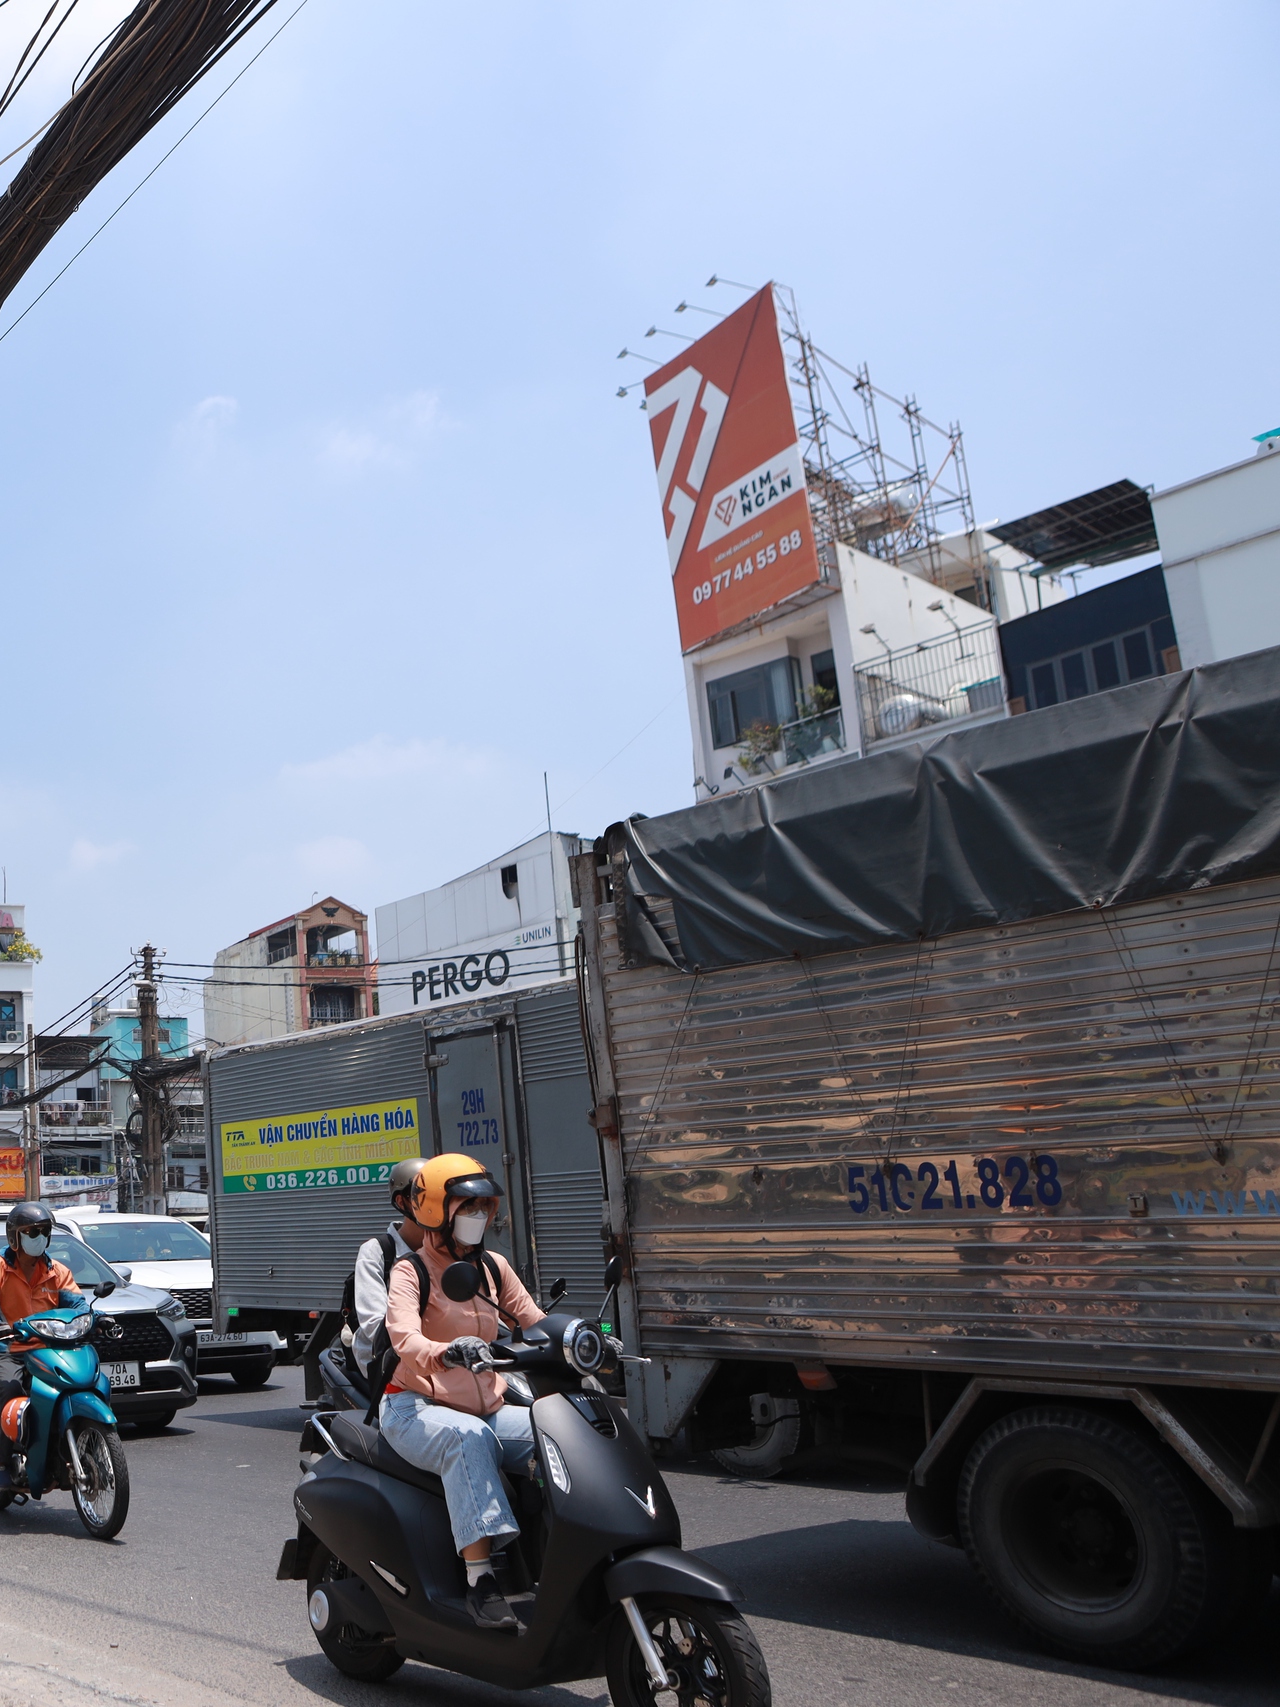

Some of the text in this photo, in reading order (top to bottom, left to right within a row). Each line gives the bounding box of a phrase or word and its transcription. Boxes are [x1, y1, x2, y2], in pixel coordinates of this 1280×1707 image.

[740, 471, 772, 500] KIM
[742, 475, 792, 516] NGAN
[692, 530, 802, 604] 09 77 44 55 88
[522, 926, 552, 944] UNILIN
[412, 949, 510, 1005] PERGO
[462, 1088, 485, 1116] 29H
[226, 1130, 246, 1142] TTA
[258, 1106, 414, 1148] VẬN CHUYỂN HÀNG HÓA
[457, 1118, 499, 1146] 722.73
[244, 1152, 275, 1169] TRUNG
[277, 1150, 300, 1168] NAM
[303, 1150, 311, 1164] &
[314, 1146, 335, 1164] CÁC
[397, 1134, 419, 1157] TÂY
[266, 1165, 395, 1190] 036.226.00.2
[200, 1332, 243, 1343] 63A-274.60
[109, 1375, 136, 1386] 69.48
[110, 1364, 127, 1374] 70A
